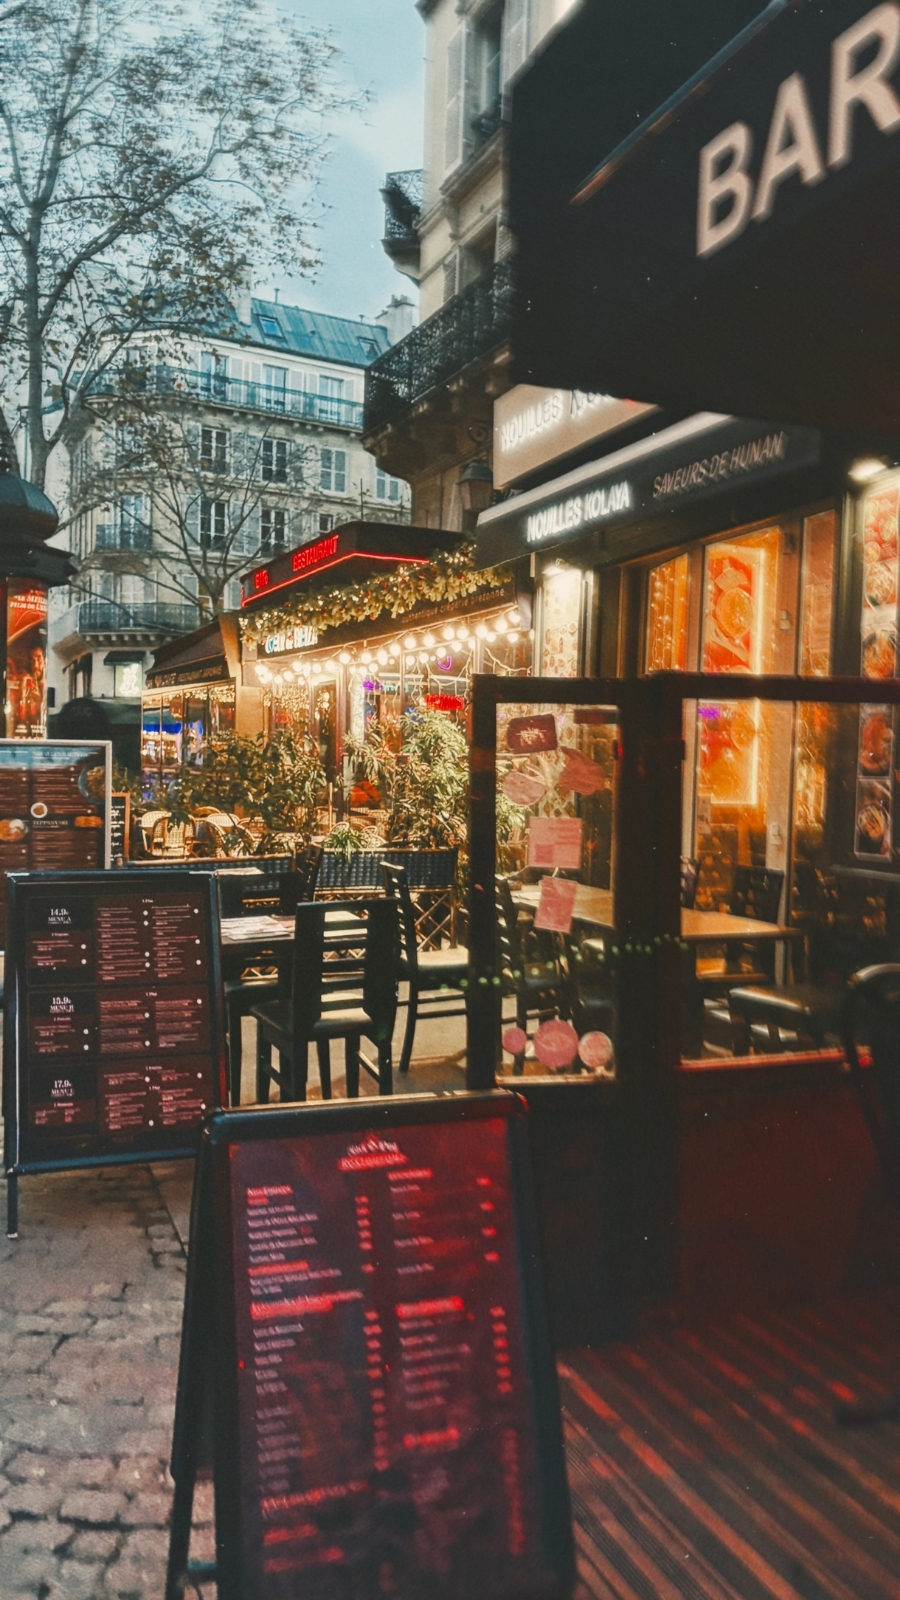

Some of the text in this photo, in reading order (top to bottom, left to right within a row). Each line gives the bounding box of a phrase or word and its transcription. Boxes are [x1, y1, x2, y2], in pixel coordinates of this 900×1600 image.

[696, 1, 900, 258] BAR
[500, 388, 562, 454] NOUILLES
[652, 430, 788, 500] SAVEURS DE HUNAN
[526, 479, 632, 543] NOUILLES KOLAYA
[292, 534, 339, 572] RESTAURANT
[470, 588, 505, 606] bretonne
